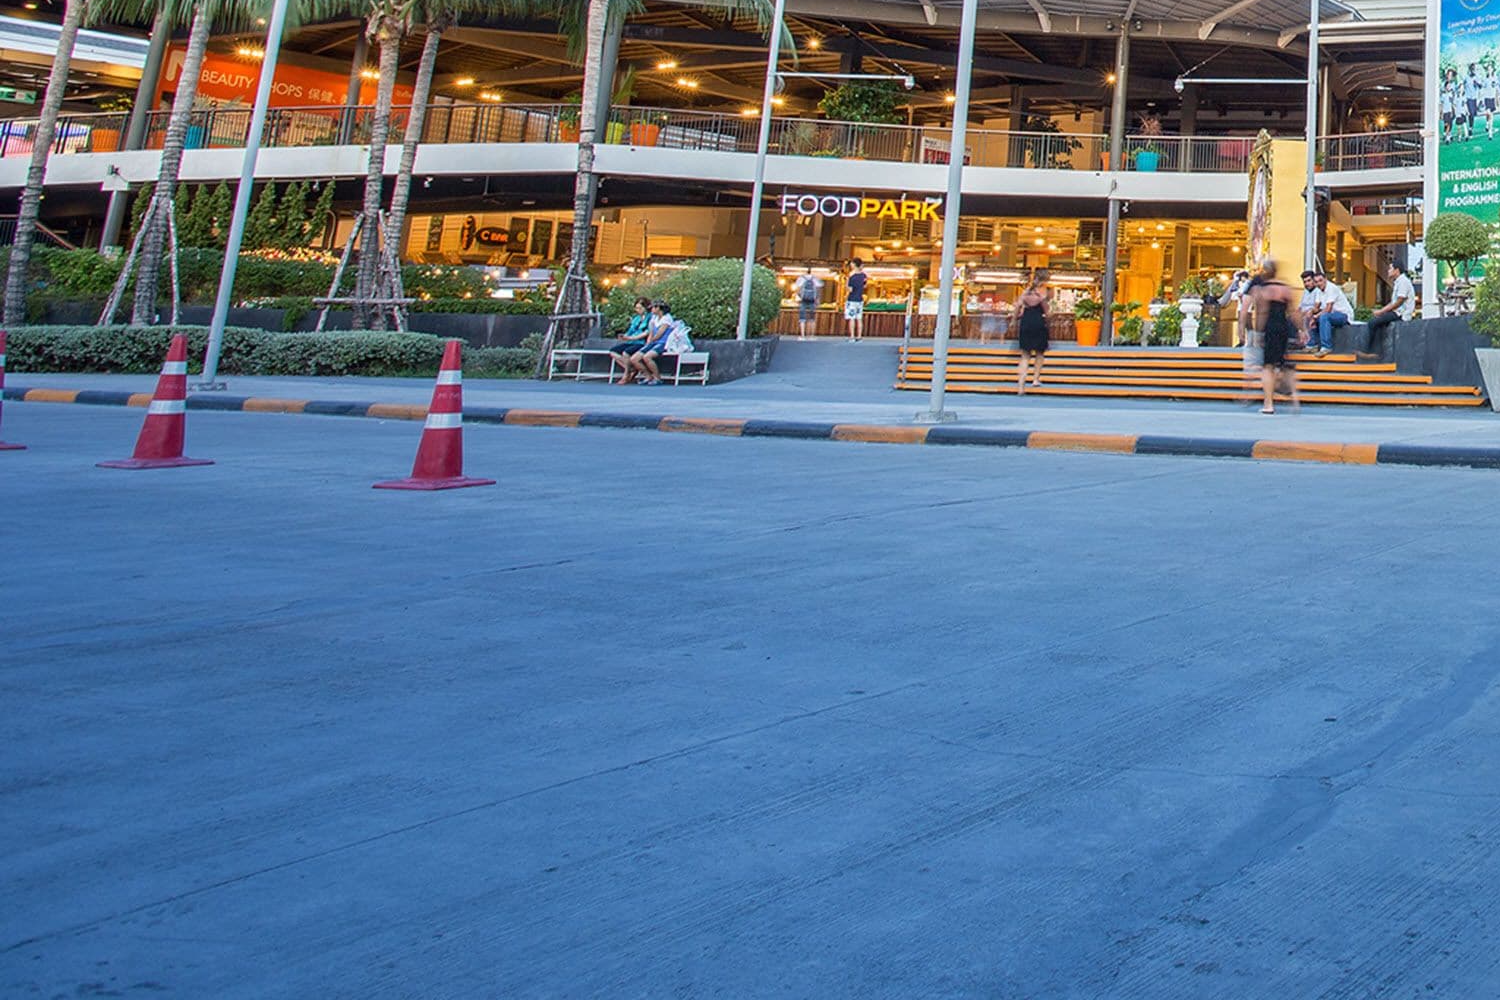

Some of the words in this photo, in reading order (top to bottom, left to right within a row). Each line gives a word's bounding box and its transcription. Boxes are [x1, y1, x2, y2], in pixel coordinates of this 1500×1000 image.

[201, 69, 254, 88] BEAUTY
[270, 82, 303, 98] HOPS
[1453, 184, 1459, 193] &
[1460, 181, 1498, 193] ENGLISH
